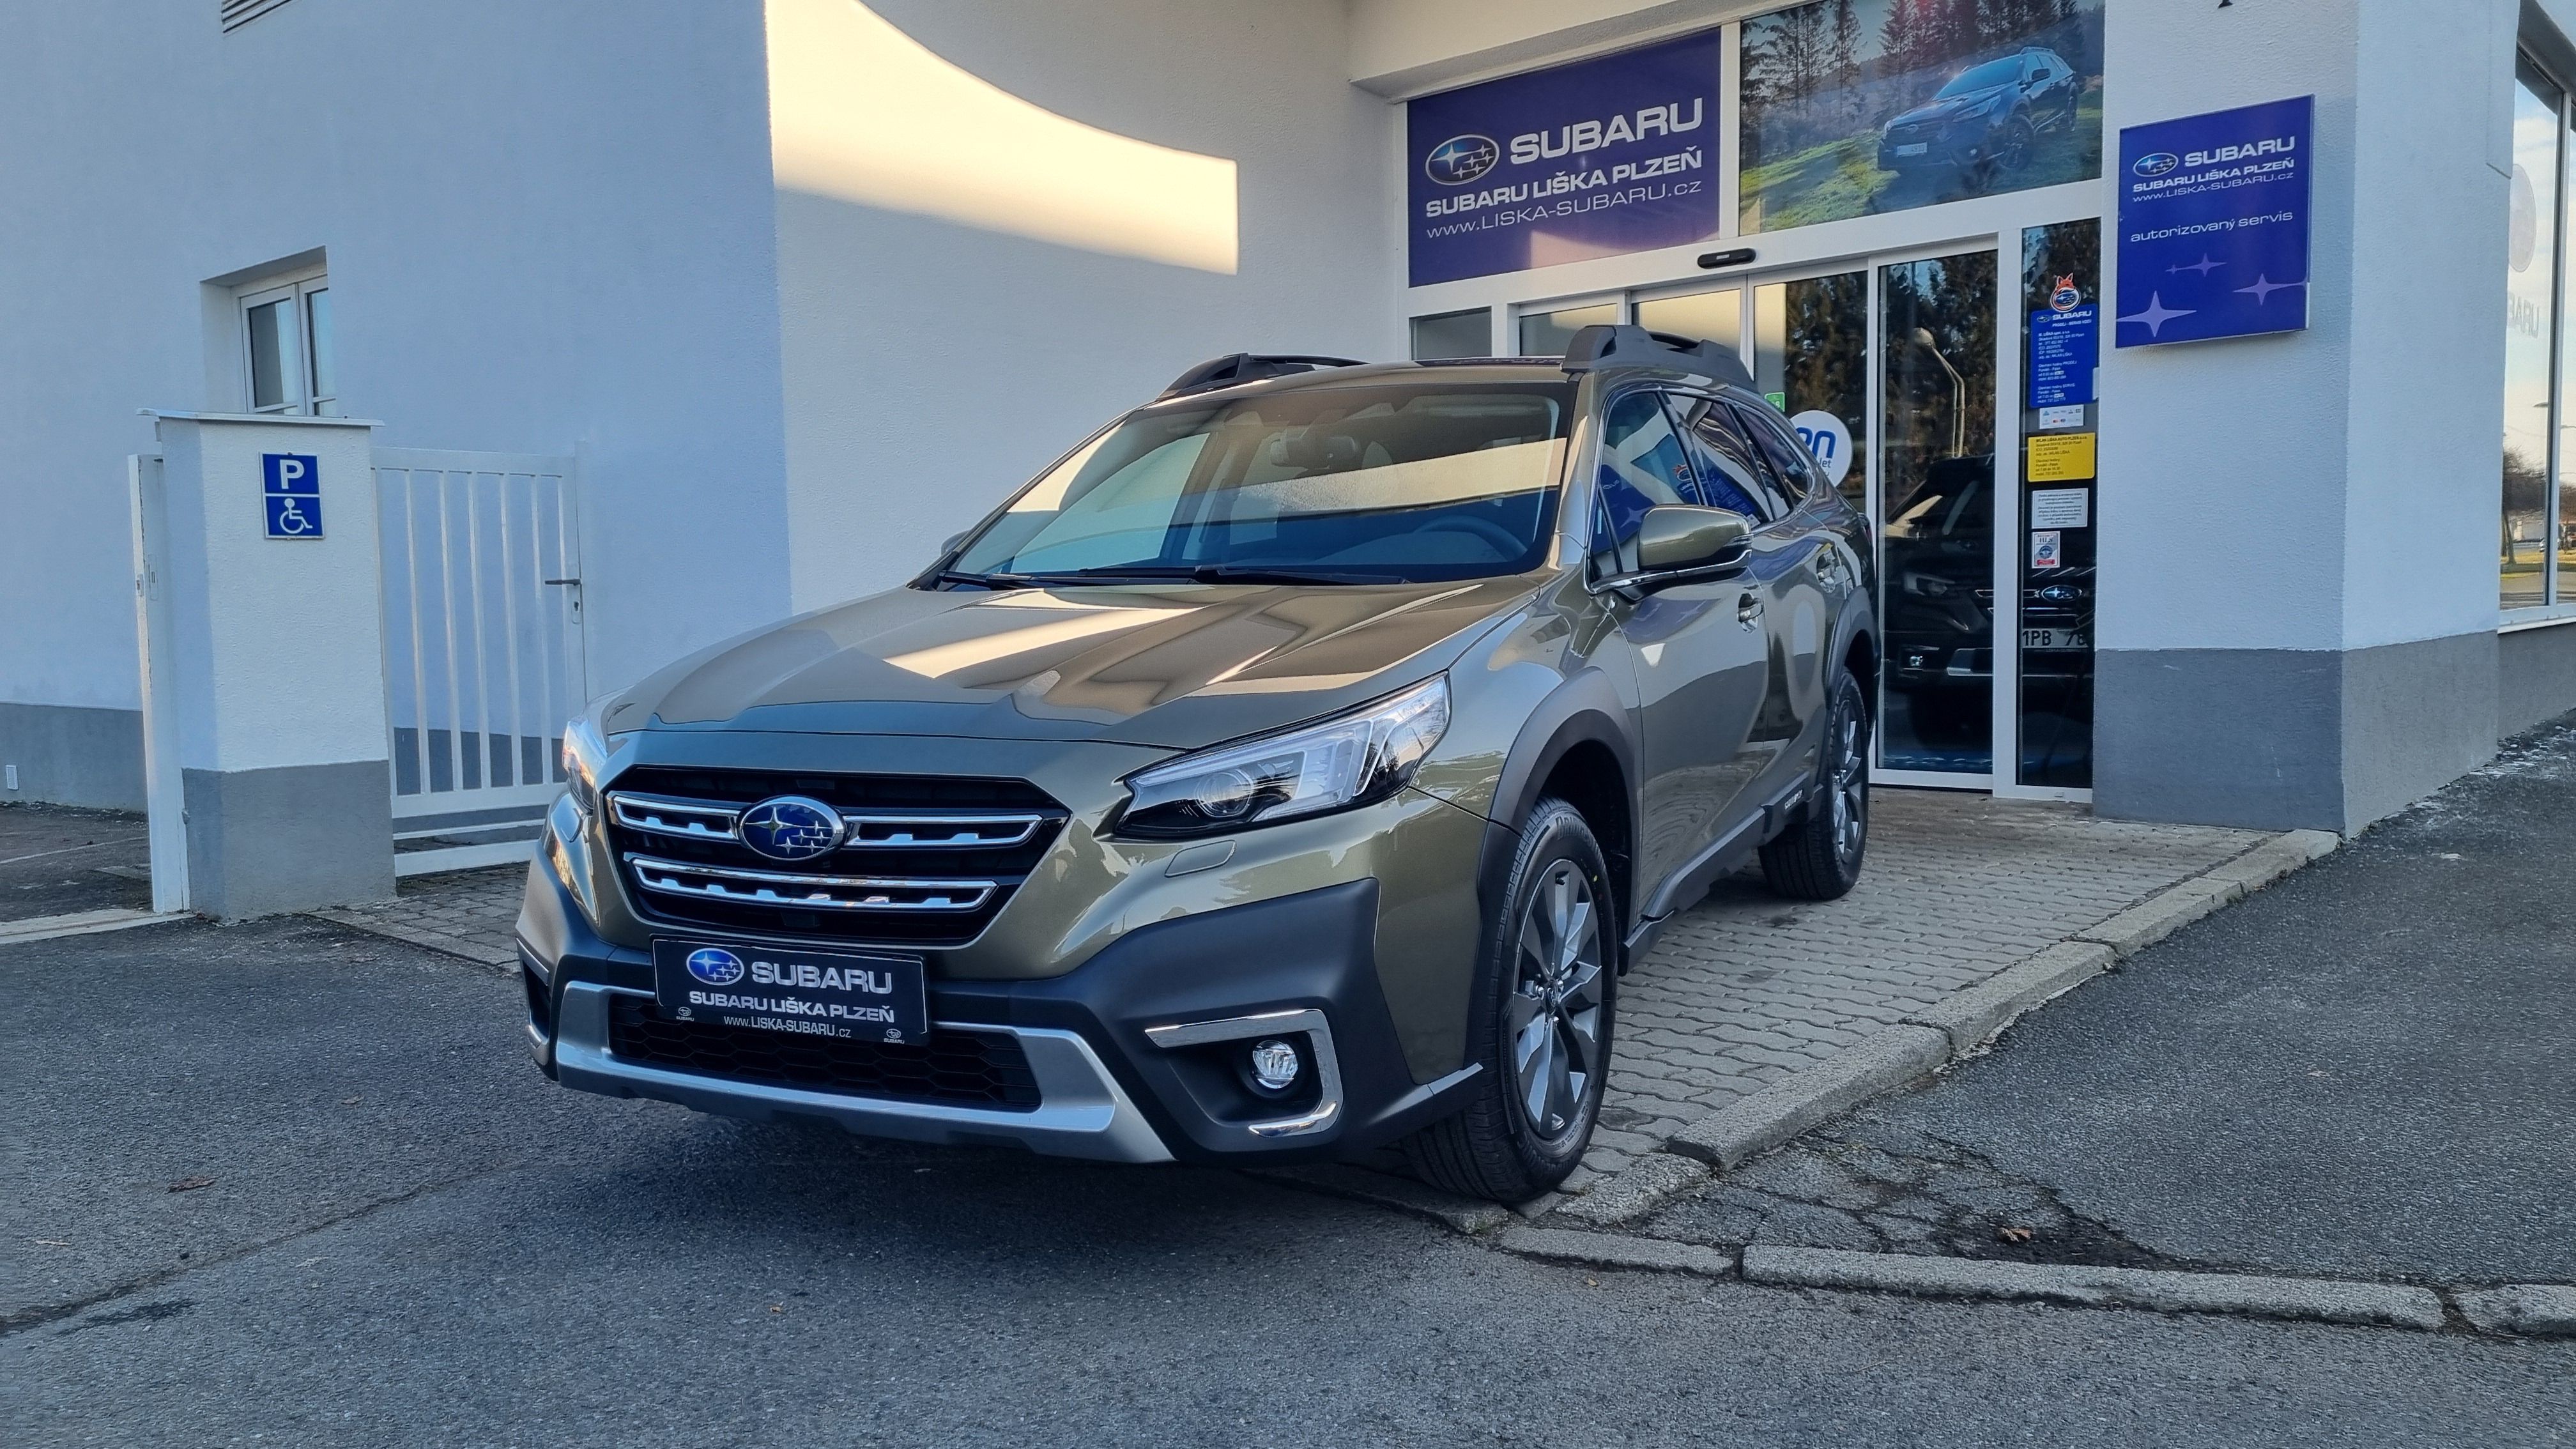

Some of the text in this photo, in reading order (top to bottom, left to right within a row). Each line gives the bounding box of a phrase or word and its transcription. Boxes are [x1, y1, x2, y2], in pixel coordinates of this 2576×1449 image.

[1510, 97, 1703, 165] SUBARU
[2184, 136, 2295, 167] SUBARU
[1425, 145, 1703, 218] SUBARU LIŠKA PLZEŇ
[2133, 157, 2294, 192] SUBARU LIŠKA PLZEŇ
[2133, 172, 2294, 203] www.LISKA-SUBARU.cz
[1426, 180, 1702, 239] www.LISKA-SUBARU.cz
[2131, 211, 2294, 242] autorizovaný servis
[2051, 310, 2092, 321] SUBARU
[280, 459, 305, 489] P
[2022, 630, 2052, 646] 1PB
[751, 961, 893, 995] SUBARU
[689, 990, 894, 1023] SUBARU LIŠKA PLZEŇ
[724, 1015, 852, 1039] www.LISKA-SUBARU.cz
